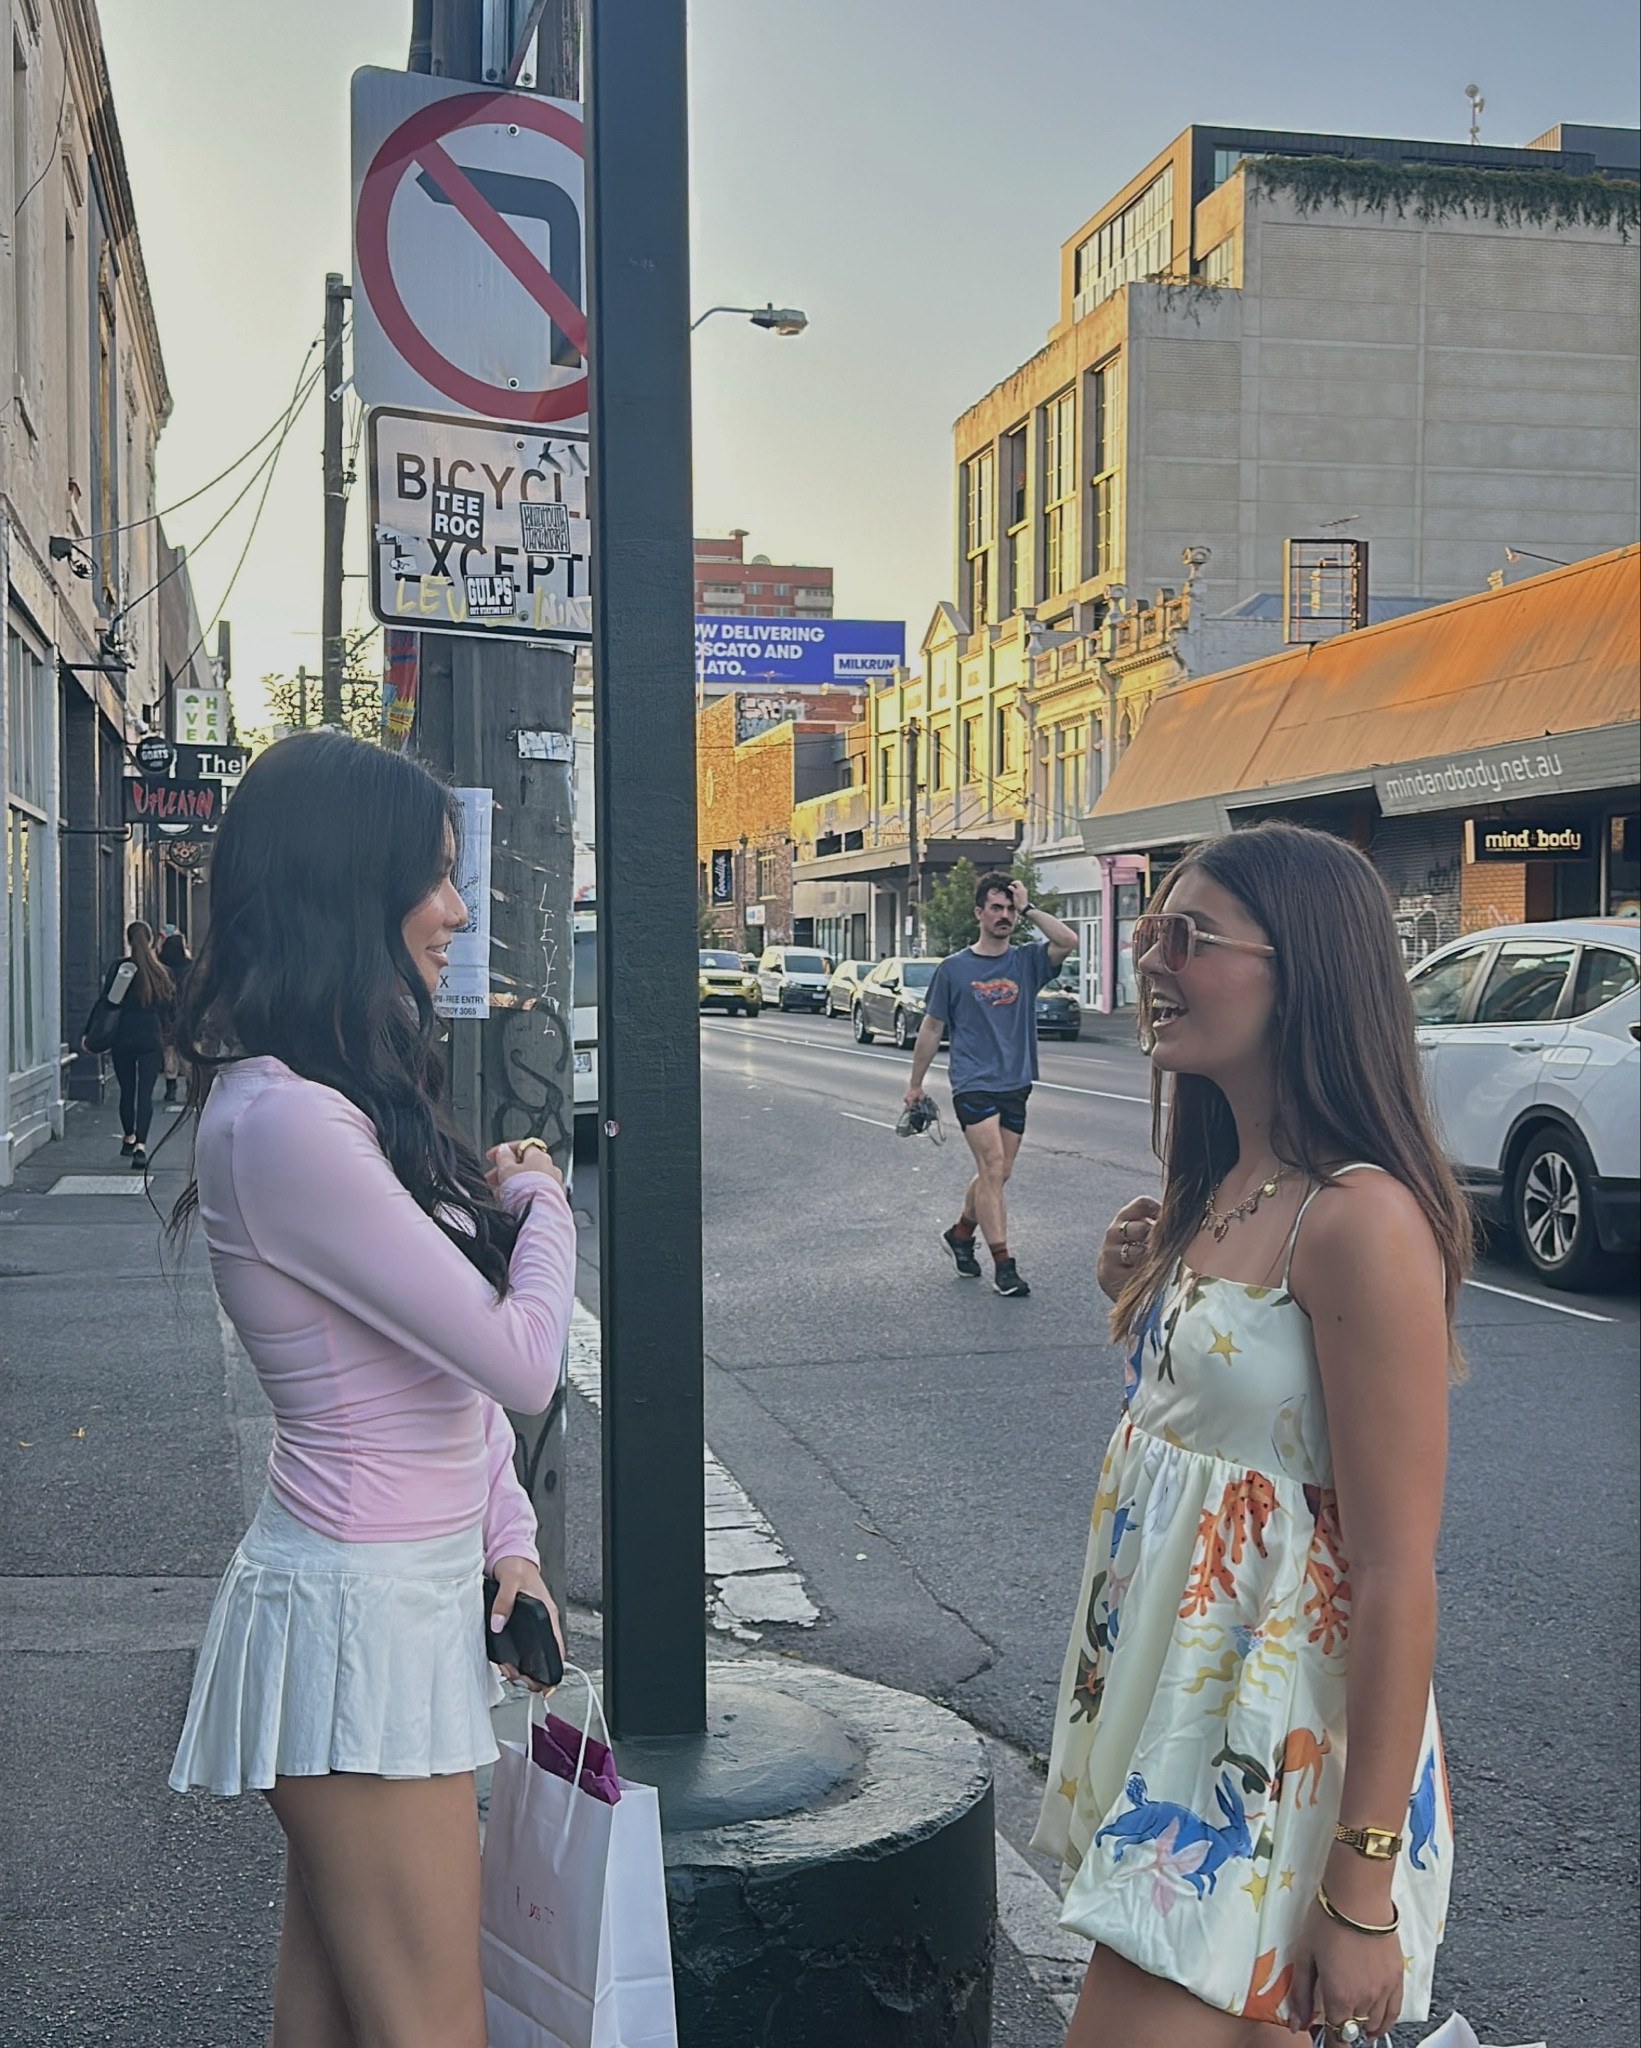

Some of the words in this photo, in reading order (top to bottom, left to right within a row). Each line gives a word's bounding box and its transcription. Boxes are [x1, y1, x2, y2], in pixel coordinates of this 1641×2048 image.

[435, 491, 480, 516] TEE
[434, 513, 480, 539] ROC
[466, 577, 513, 606] GULPS
[721, 624, 825, 642] DELIVERING
[764, 643, 803, 660] AND
[839, 658, 895, 670] MILKRUN
[1386, 753, 1563, 800] mindandbody.net.au
[1485, 829, 1530, 848] mind
[1536, 829, 1581, 850] body
